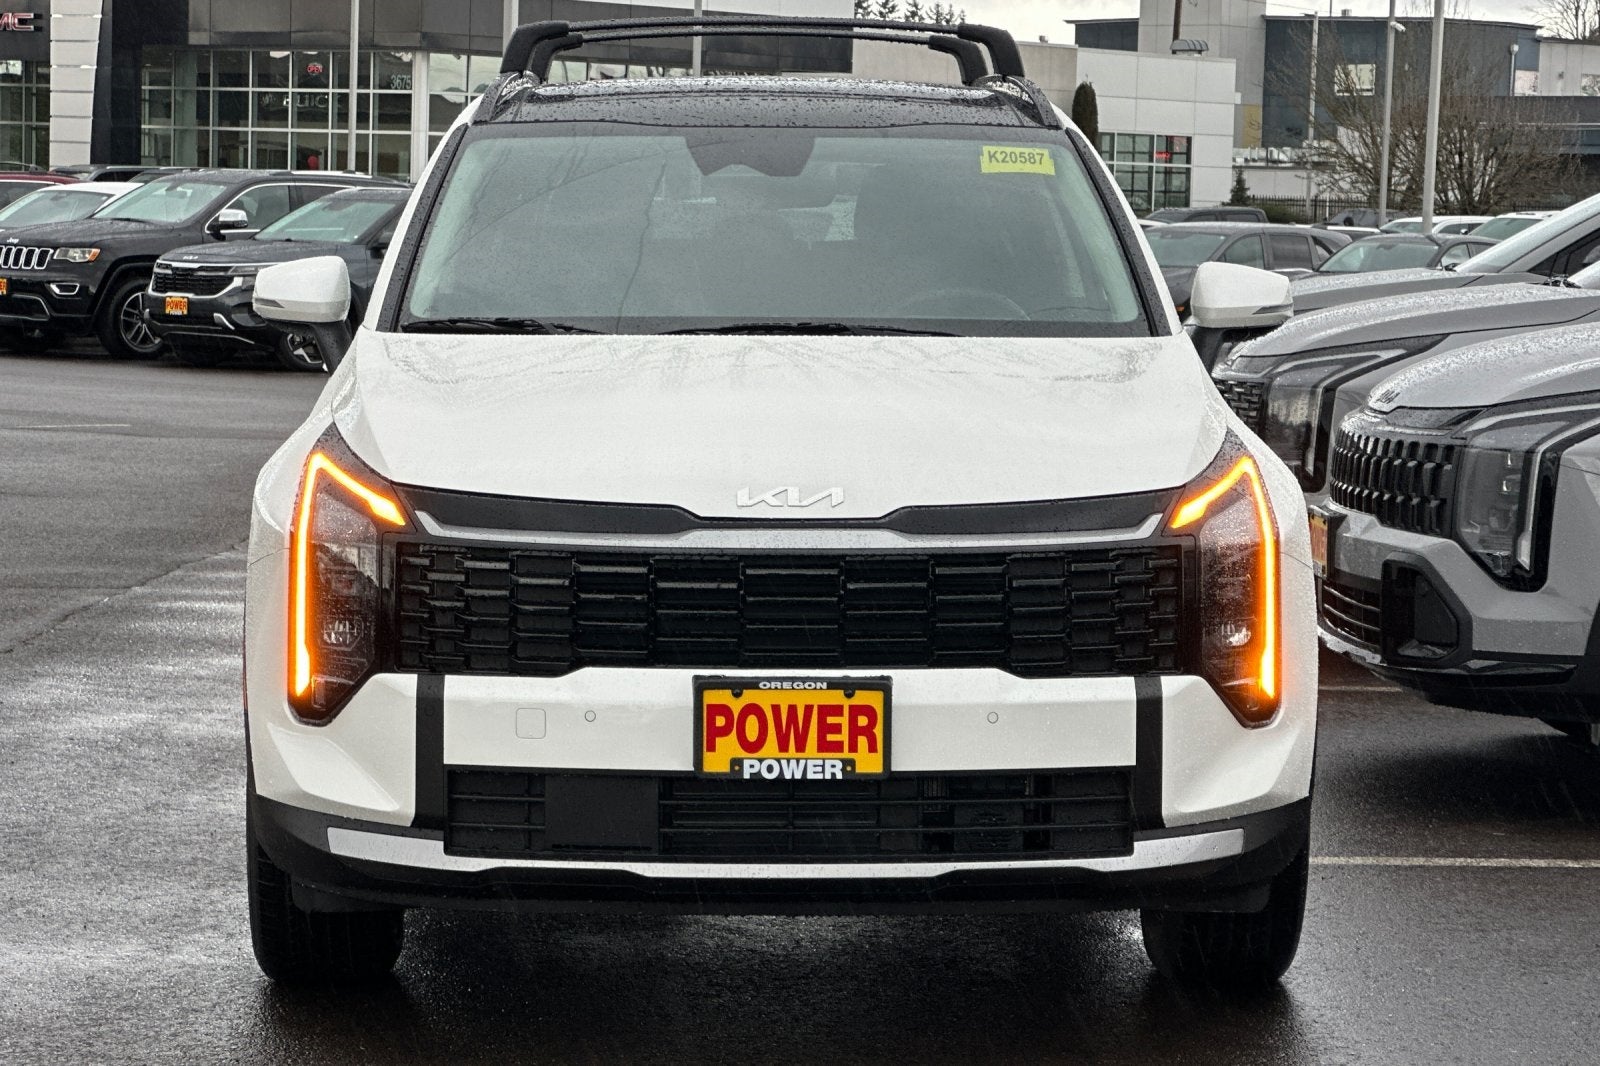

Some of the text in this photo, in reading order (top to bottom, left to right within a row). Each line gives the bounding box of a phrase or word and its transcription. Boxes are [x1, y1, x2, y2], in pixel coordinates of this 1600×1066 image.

[307, 64, 322, 72] OPEN
[391, 75, 411, 89] 3675
[988, 150, 1044, 165] K20587
[167, 300, 187, 310] POWER
[737, 486, 844, 508] KIA
[706, 703, 878, 754] POWER
[743, 759, 843, 779] POWER
